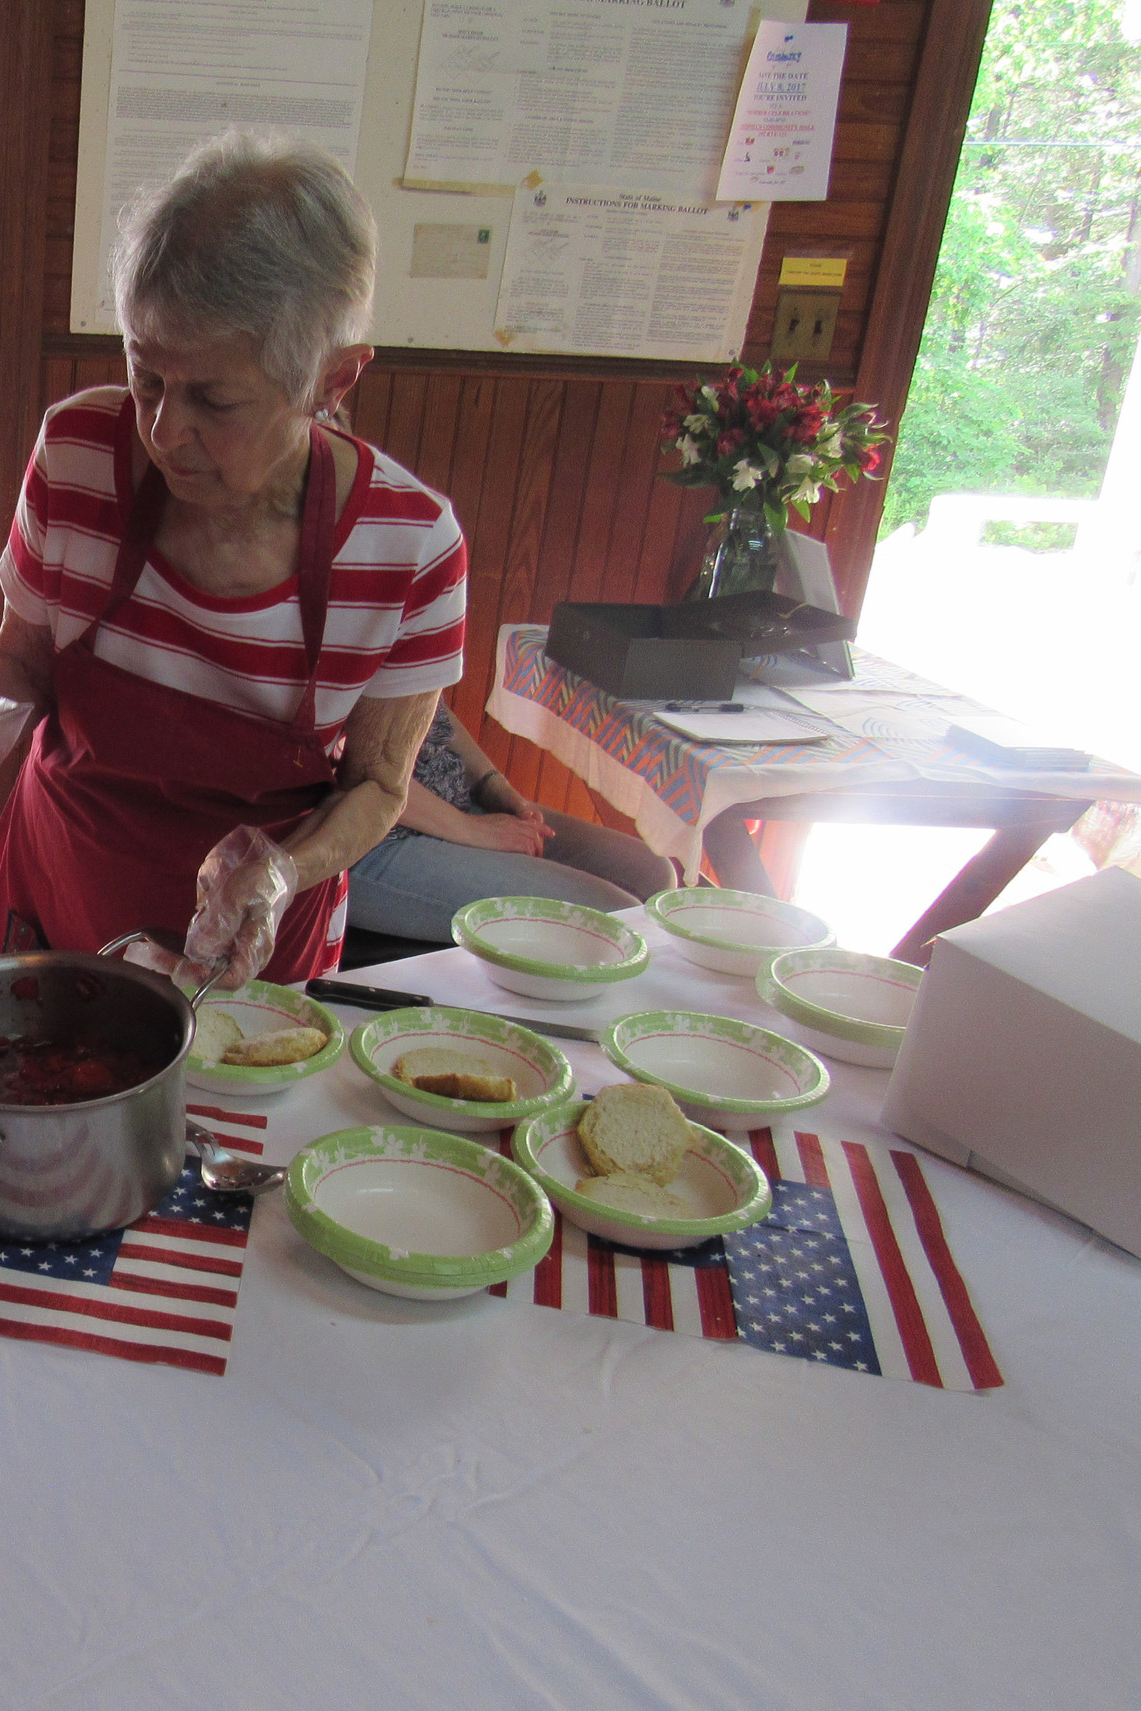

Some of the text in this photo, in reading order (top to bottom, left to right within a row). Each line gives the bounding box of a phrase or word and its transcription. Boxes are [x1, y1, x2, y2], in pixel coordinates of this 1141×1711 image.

[646, 0, 685, 8] BALLOT
[786, 83, 806, 91] 2017
[565, 197, 622, 207] INSTRUCTIONS
[623, 201, 639, 209] FOR
[640, 202, 676, 213] MARKING
[678, 206, 709, 215] BALLOT
